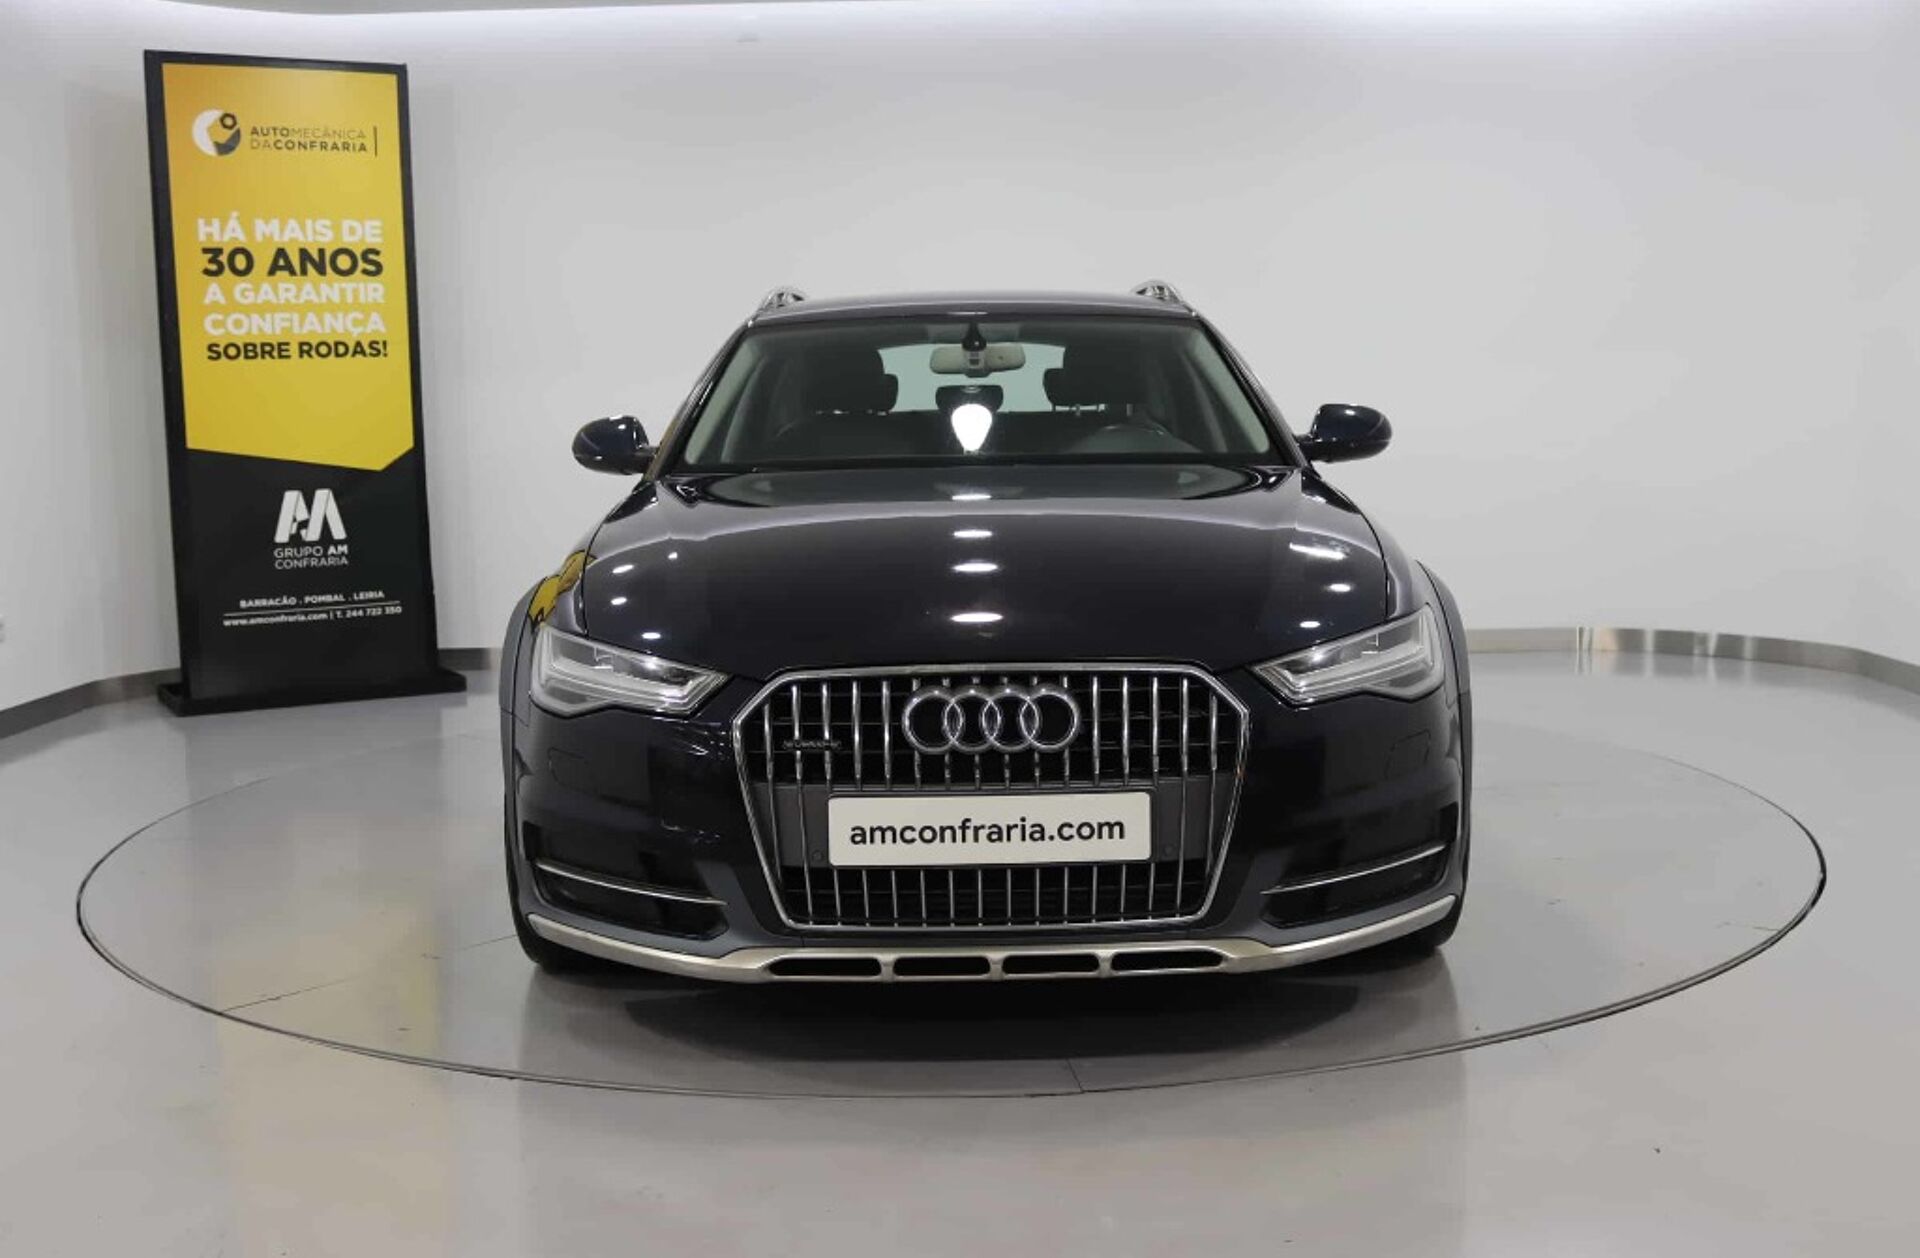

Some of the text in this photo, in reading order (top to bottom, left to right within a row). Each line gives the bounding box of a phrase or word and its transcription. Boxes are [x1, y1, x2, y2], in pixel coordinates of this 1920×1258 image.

[197, 211, 383, 243] HÁ MAIS DE
[201, 247, 384, 277] 30 ANOS
[204, 281, 385, 304] A GARANTIR
[203, 311, 386, 337] CONFIANÇA
[207, 340, 388, 361] SOBRE RODAS!
[274, 544, 348, 558] GRUPO AM
[274, 556, 348, 570] CONFRARIA
[239, 590, 385, 608] BARRACÃO POMBAL LEIRIA
[223, 612, 328, 626] www.amconfraria.com
[346, 608, 364, 618] 244
[849, 816, 1126, 845] amconfraria.com
